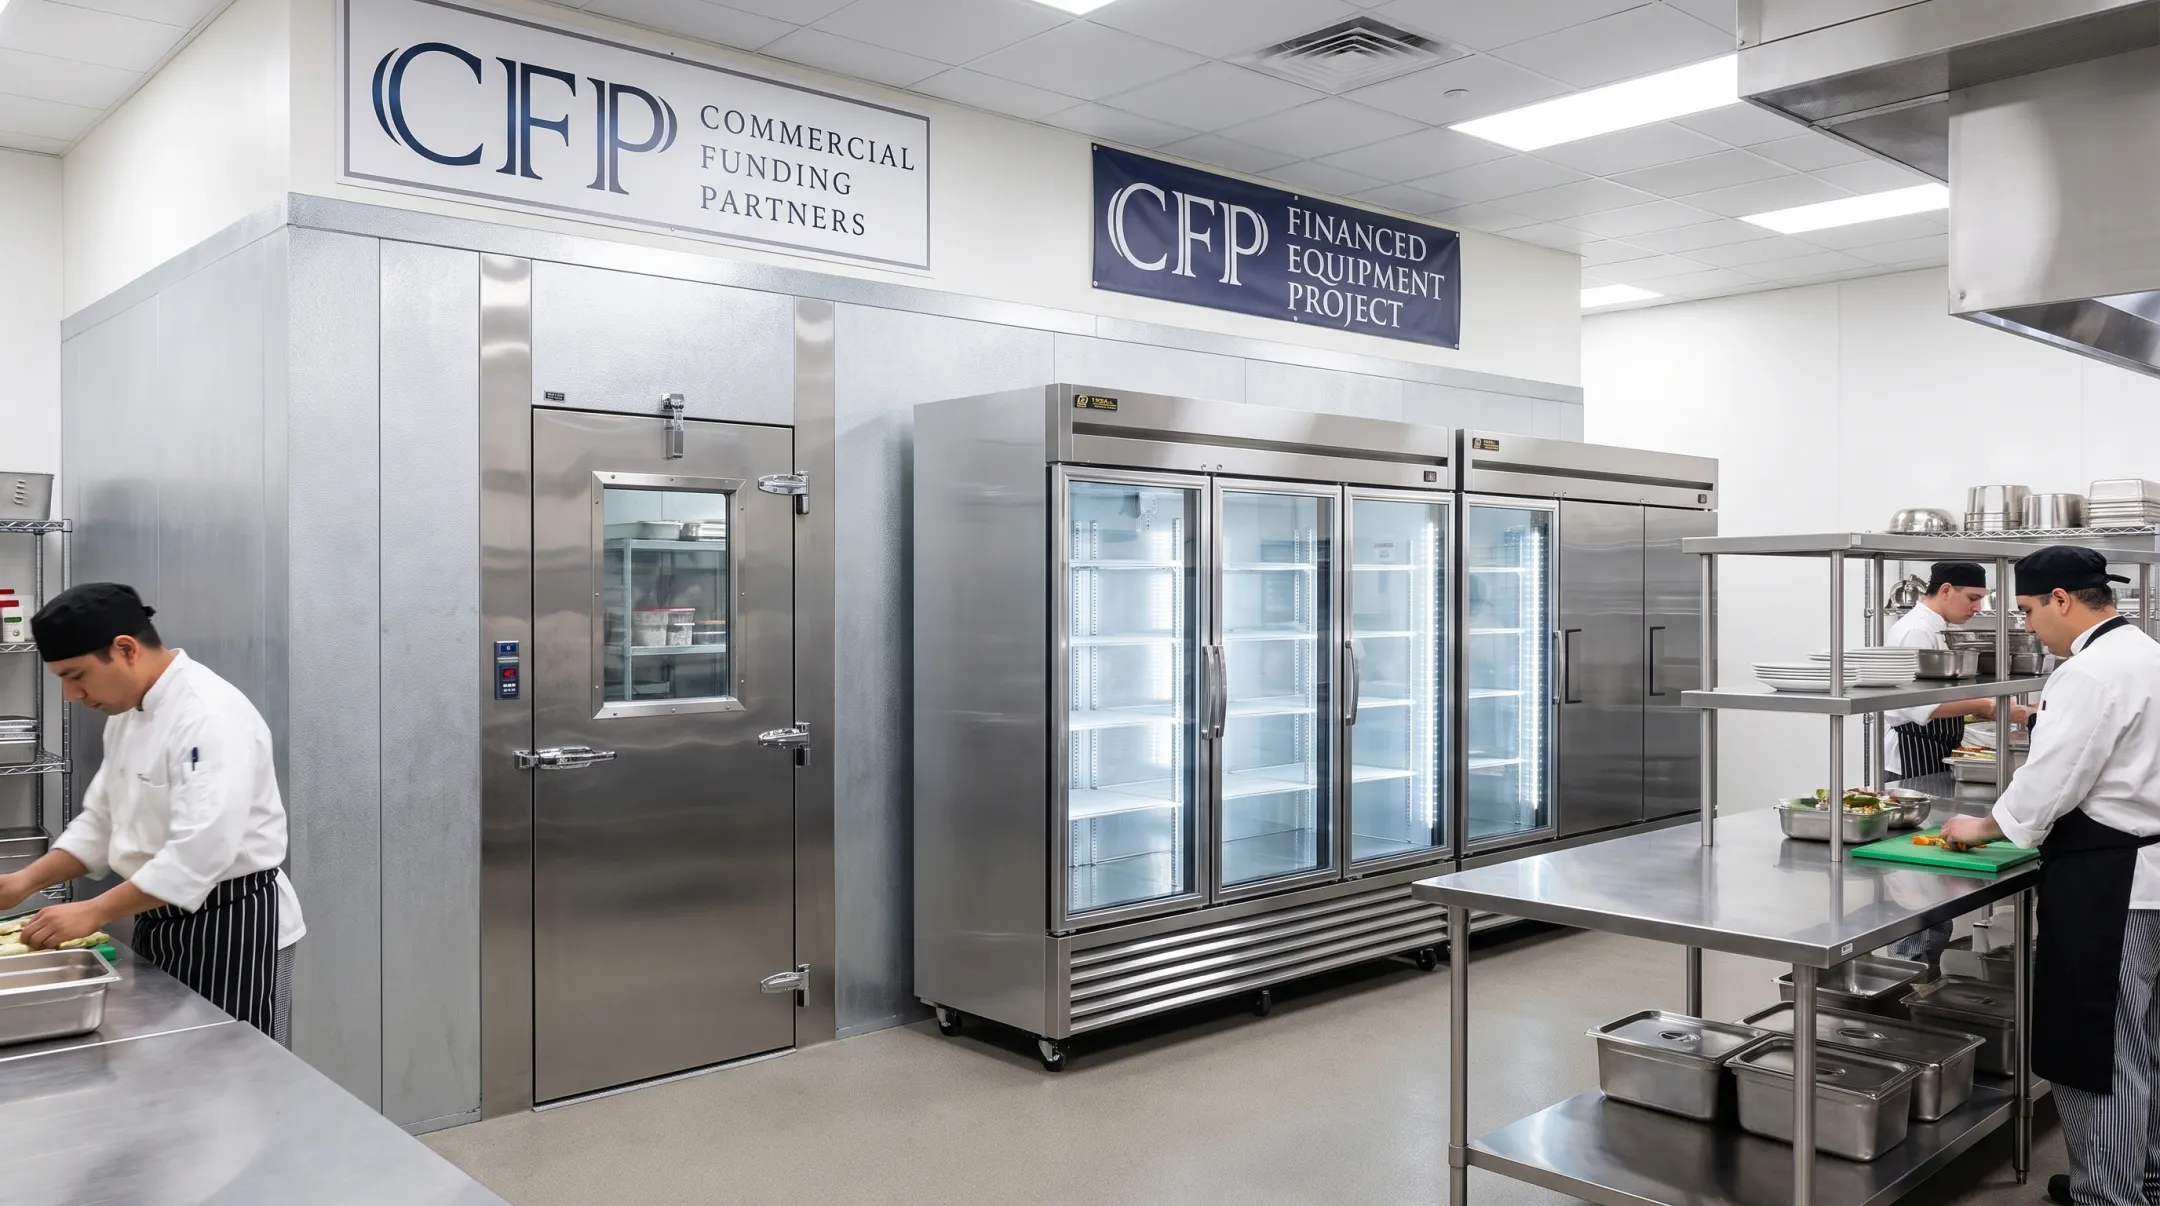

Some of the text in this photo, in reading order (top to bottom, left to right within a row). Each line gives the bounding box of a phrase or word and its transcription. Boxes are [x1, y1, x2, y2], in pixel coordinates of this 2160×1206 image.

[371, 41, 678, 195] CFP
[700, 104, 916, 171] COMMERCIAL
[700, 144, 853, 195] FUNDING
[700, 185, 866, 236] PARTNERS
[1107, 182, 1269, 287] CFP
[1287, 206, 1427, 262] FINANCED
[1287, 243, 1445, 301] EQUIPMENT
[1287, 281, 1404, 328] PROJECT
